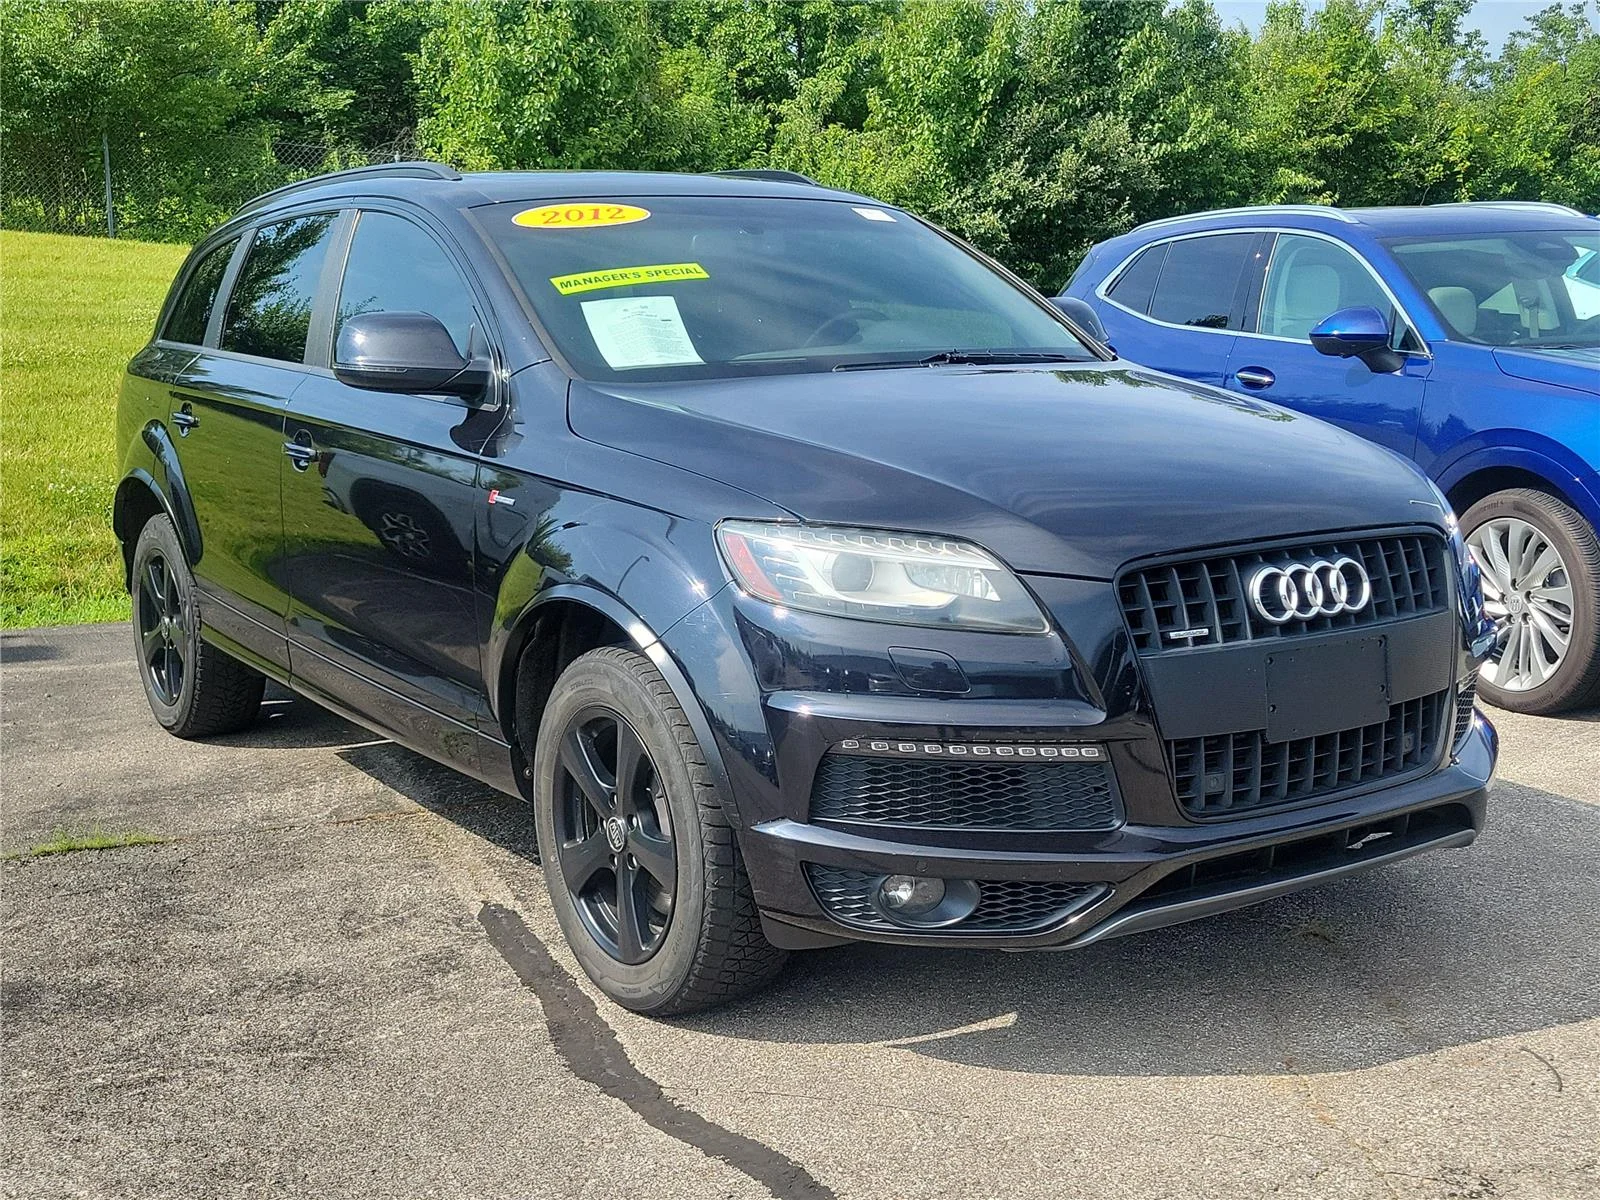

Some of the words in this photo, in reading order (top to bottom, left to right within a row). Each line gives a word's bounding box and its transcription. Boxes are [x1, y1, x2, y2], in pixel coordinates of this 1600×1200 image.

[541, 207, 626, 225] 2012
[559, 271, 641, 289] MANAGER'S
[645, 266, 702, 278] SPECIAL
